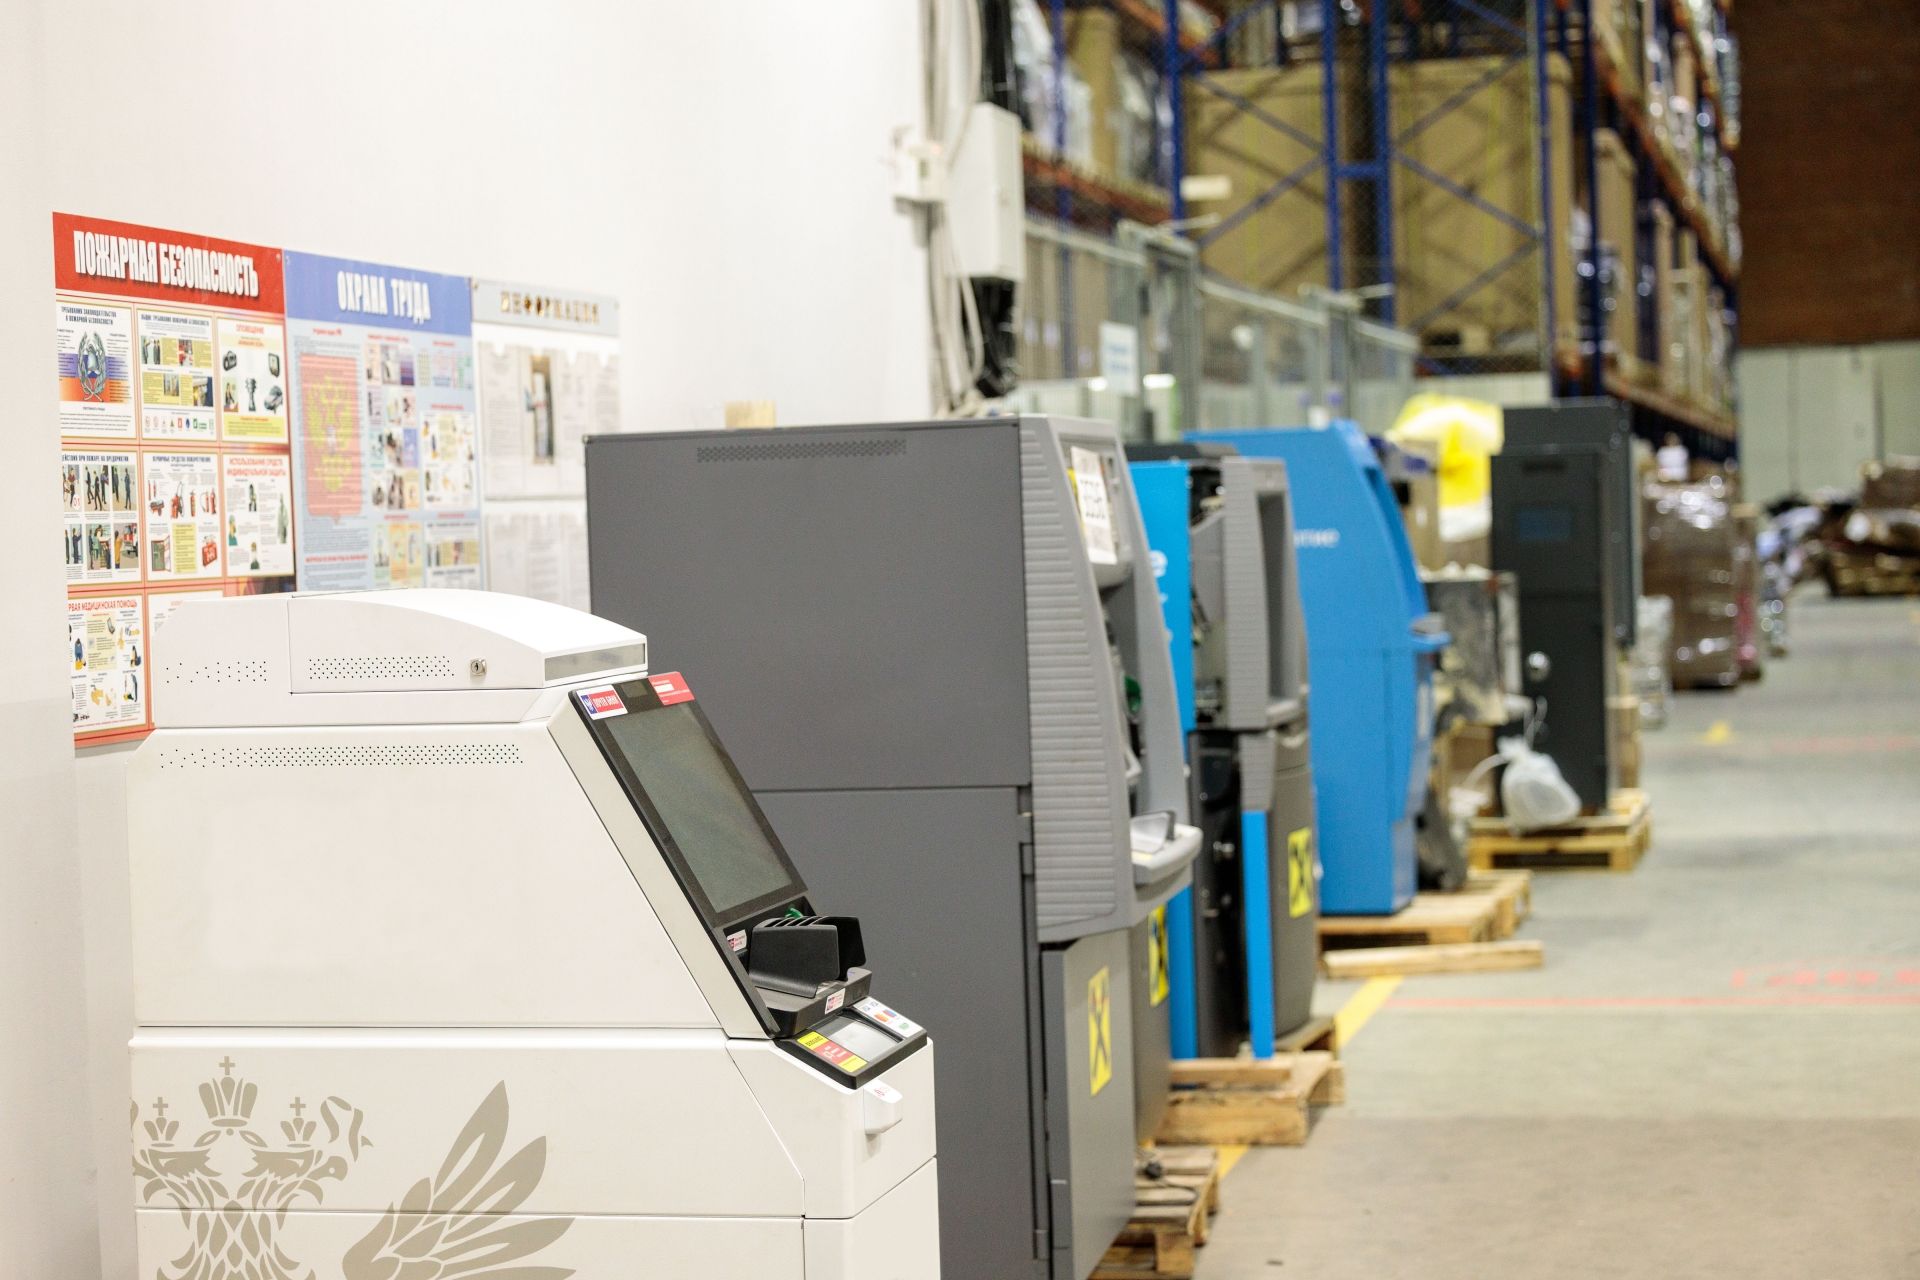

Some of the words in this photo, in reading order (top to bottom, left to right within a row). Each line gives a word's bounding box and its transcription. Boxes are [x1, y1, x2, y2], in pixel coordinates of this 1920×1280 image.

[73, 230, 158, 284] ПОЖАРНАЯ
[159, 242, 259, 297] БЕЗОПАСНОСТЬ
[336, 270, 388, 315] ОХРАНА
[390, 278, 432, 325] ТРУДА
[500, 290, 600, 325] ИНФОРМАЦИЯ
[81, 600, 116, 612] МЕДИЦИНСКАЯ
[116, 598, 138, 609] ПОМОЩЬ
